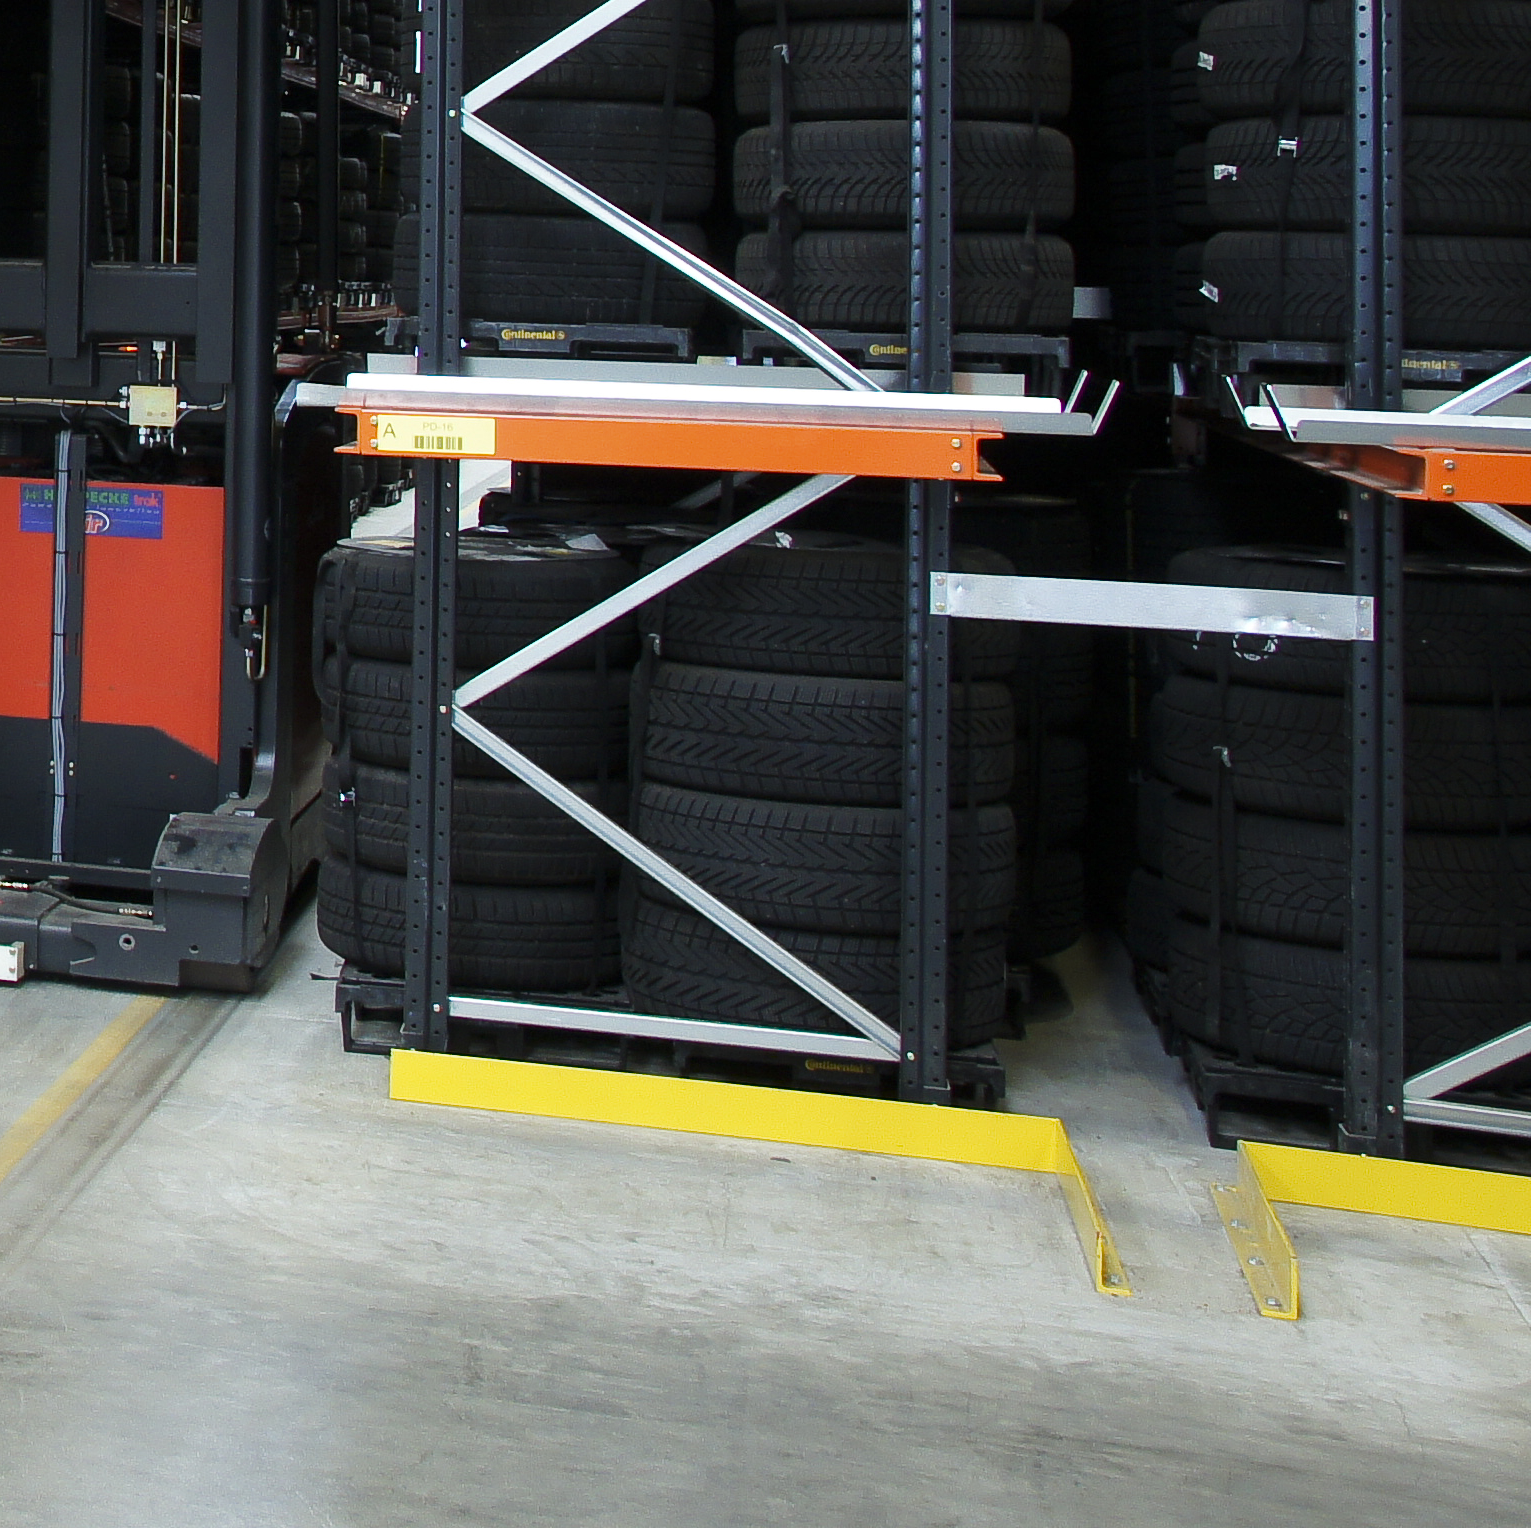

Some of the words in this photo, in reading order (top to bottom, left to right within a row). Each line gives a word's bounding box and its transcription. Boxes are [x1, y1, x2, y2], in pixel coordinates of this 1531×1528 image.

[500, 328, 556, 341] Continental
[382, 423, 396, 438] A
[422, 422, 454, 432] PD-16
